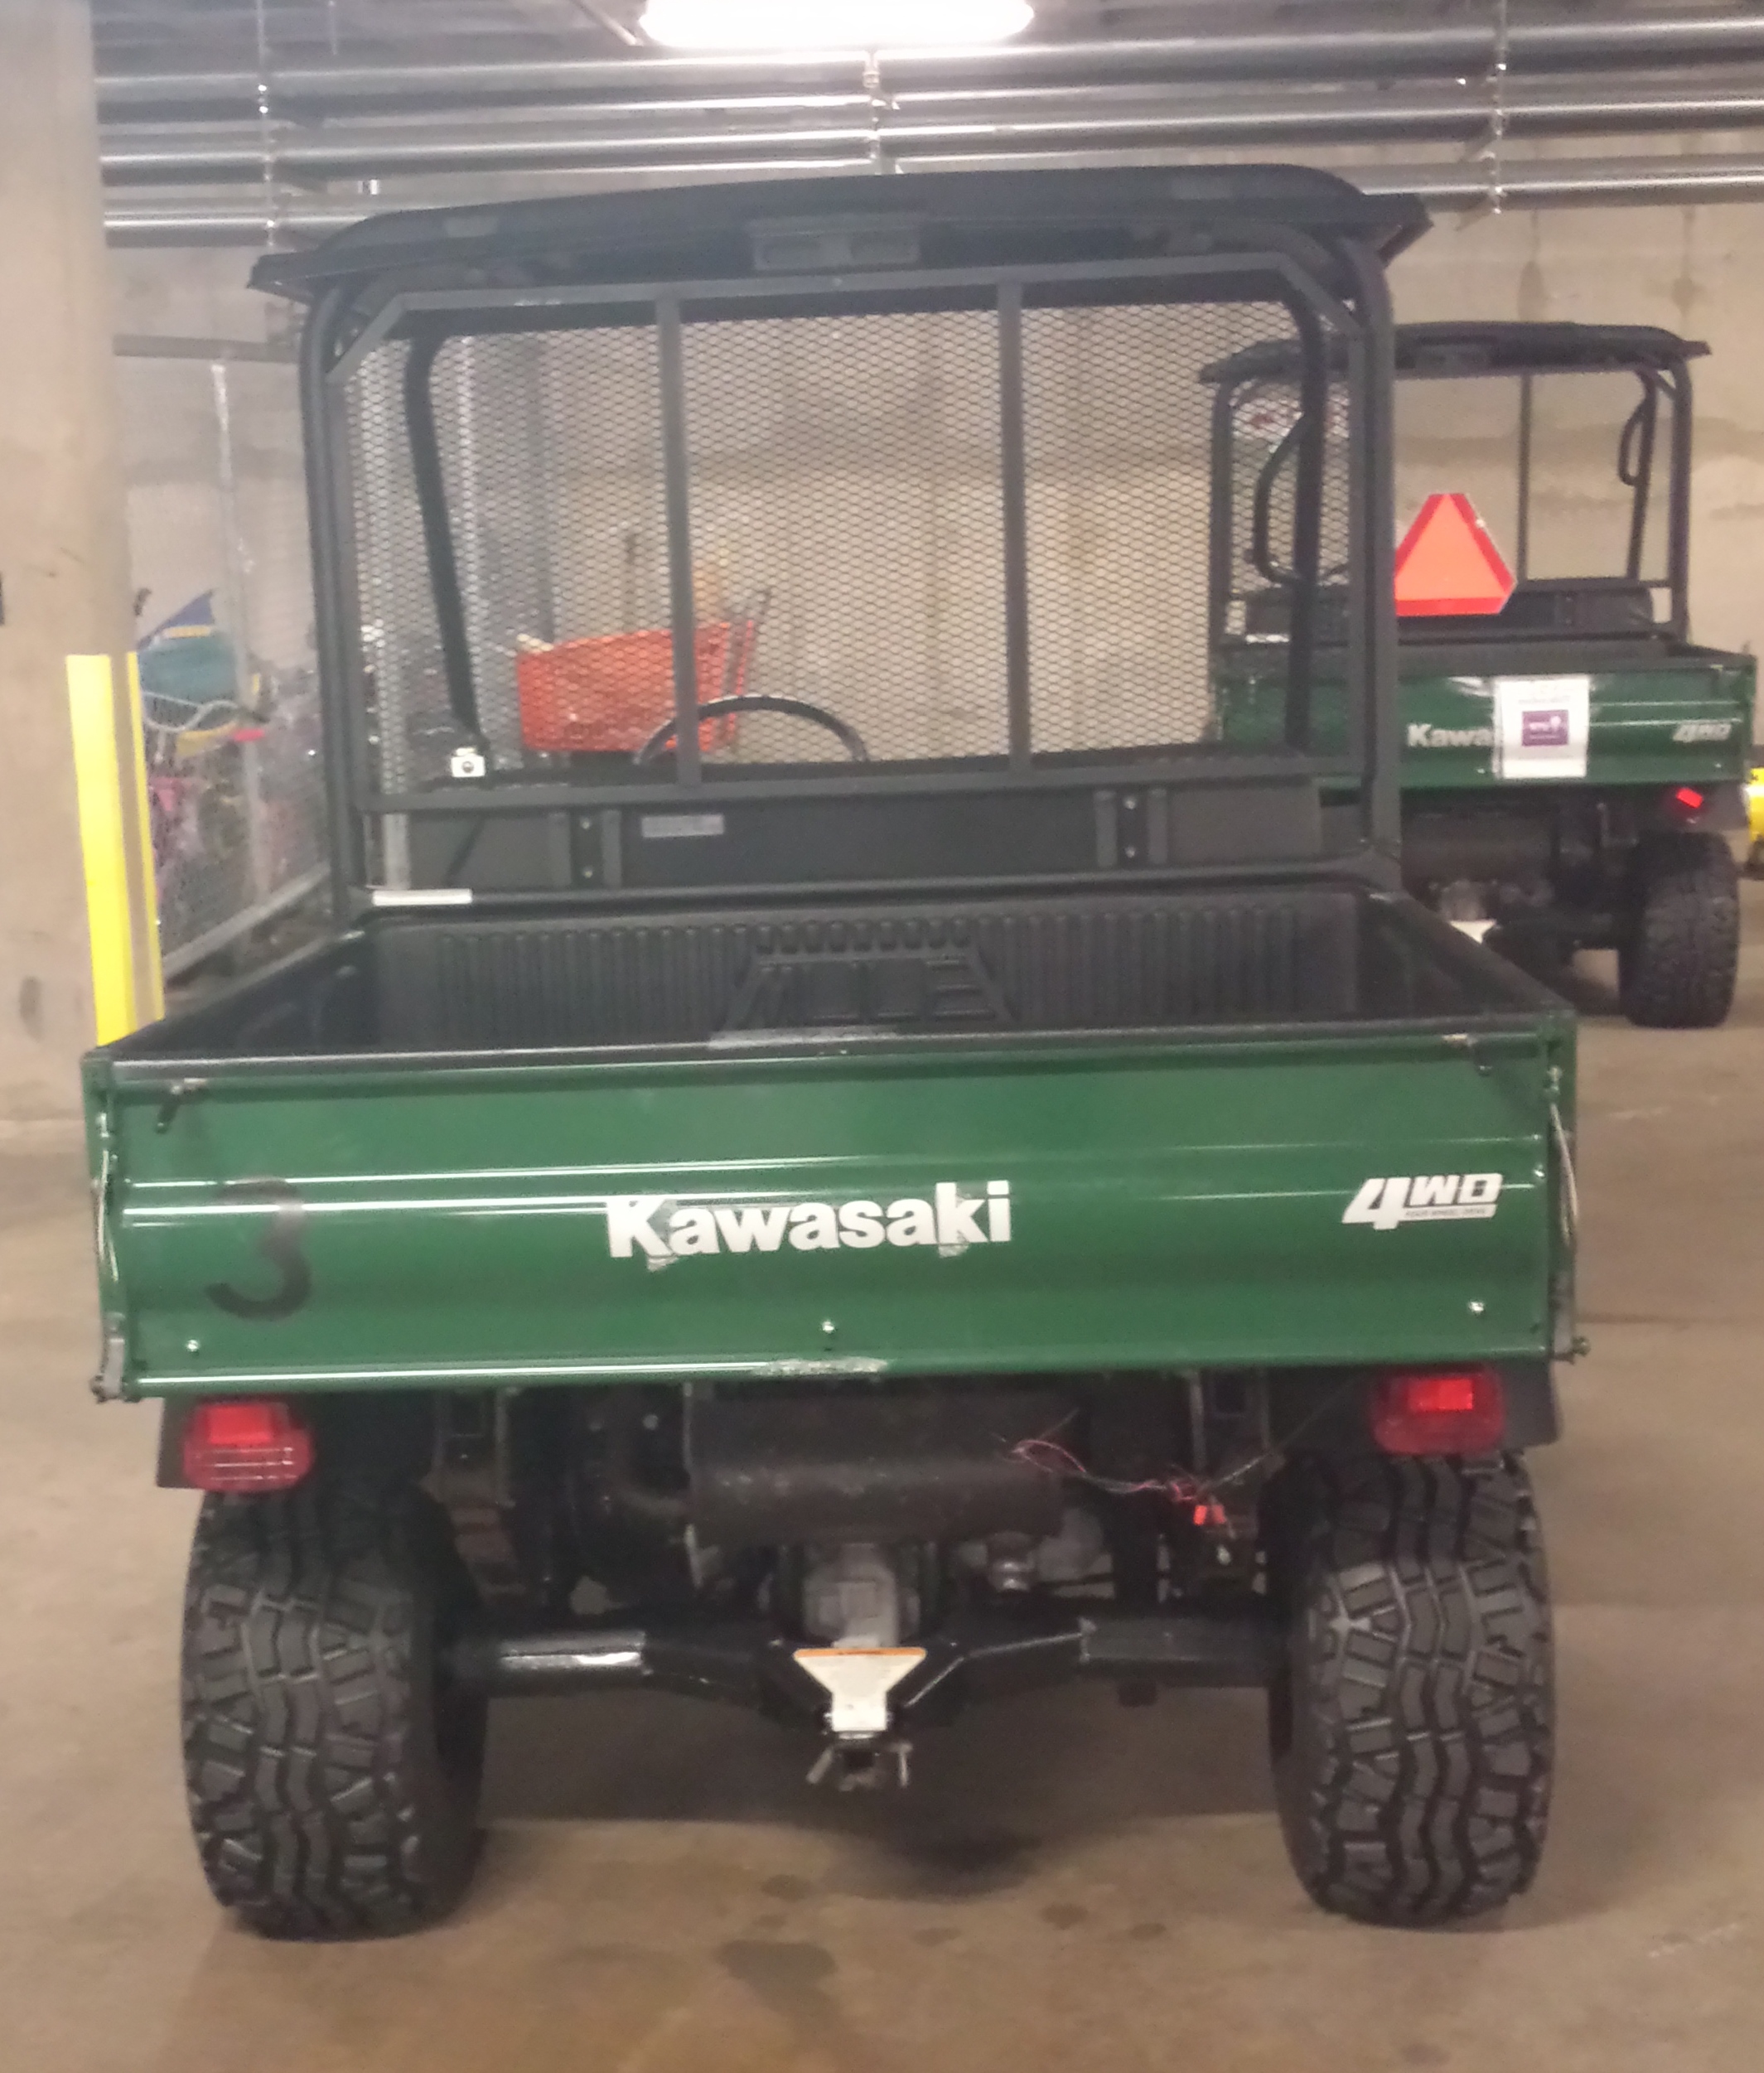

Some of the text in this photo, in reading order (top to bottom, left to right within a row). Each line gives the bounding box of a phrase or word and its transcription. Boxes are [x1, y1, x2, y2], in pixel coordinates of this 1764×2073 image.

[606, 1180, 1012, 1258] Kawasaki
[1342, 1173, 1504, 1230] 4WD
[205, 1178, 312, 1321] 3
